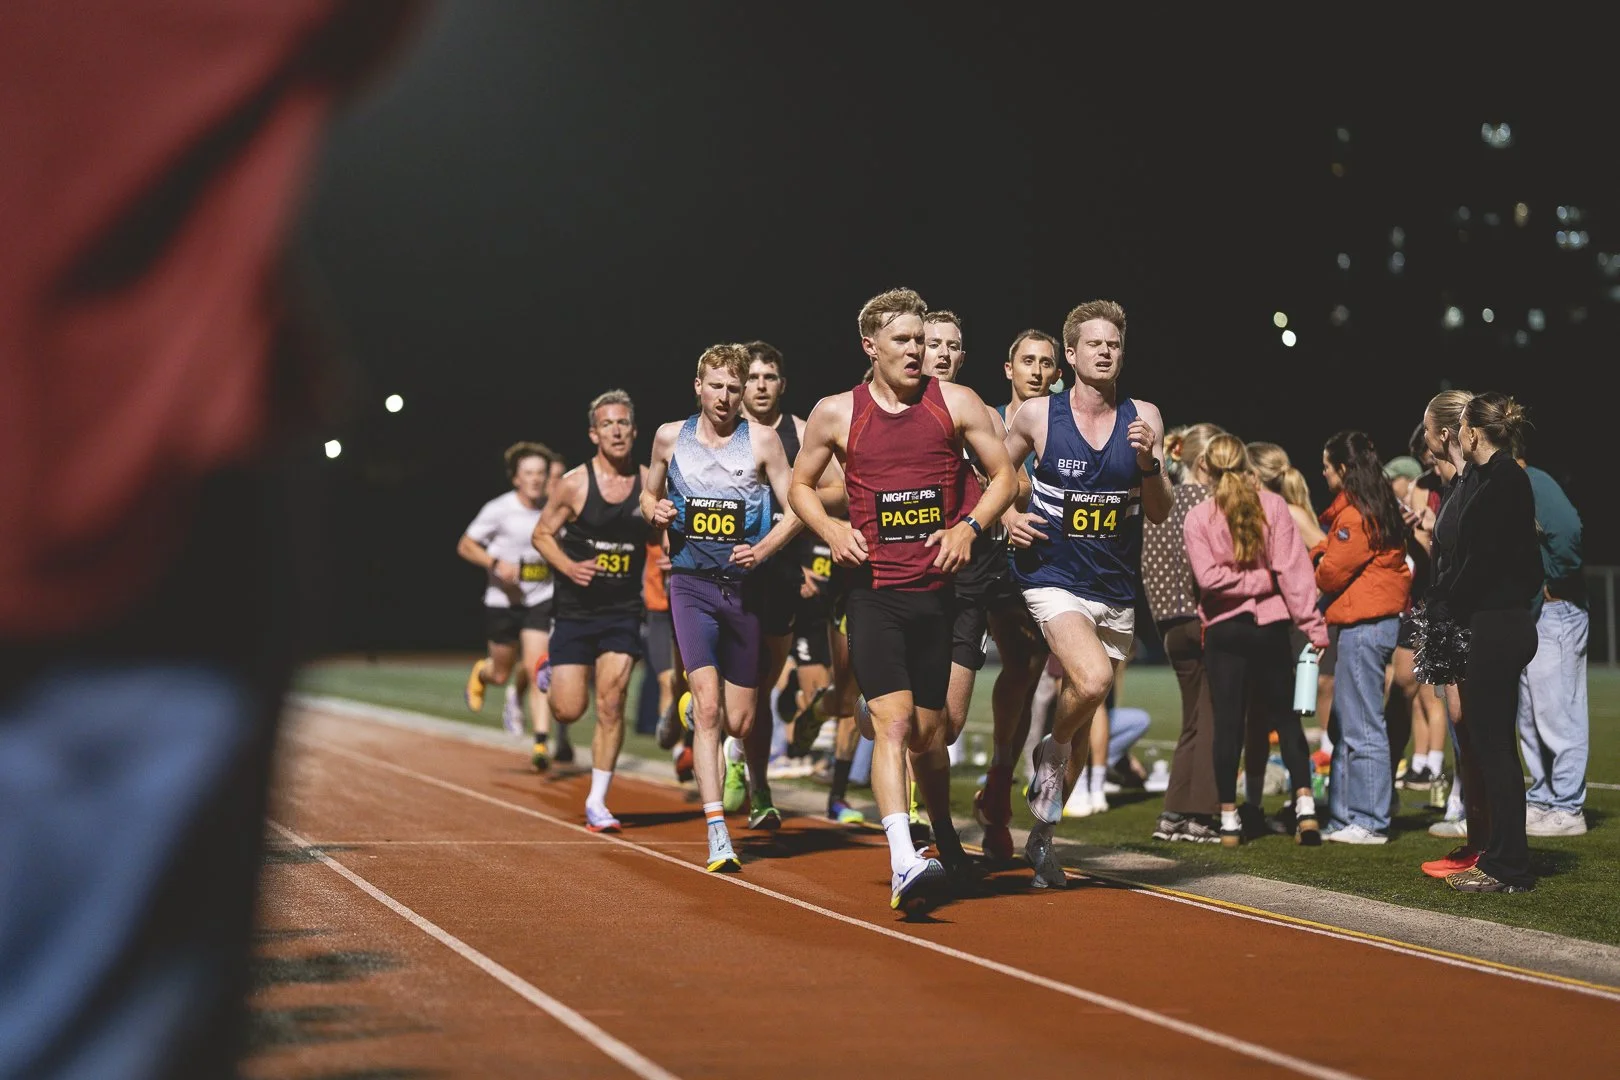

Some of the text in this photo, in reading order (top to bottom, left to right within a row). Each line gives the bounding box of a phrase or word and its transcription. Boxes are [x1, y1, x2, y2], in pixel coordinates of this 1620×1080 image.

[1057, 458, 1088, 470] BERT
[691, 499, 717, 508] NIGHT
[722, 500, 738, 509] PBs
[882, 491, 911, 503] NIGHT
[919, 489, 936, 500] PBs
[1070, 493, 1099, 503] NIGHT
[1105, 495, 1121, 504] PBs
[693, 512, 736, 535] 606
[881, 507, 941, 527] PACER
[1072, 508, 1117, 531] 614
[596, 553, 630, 573] 631
